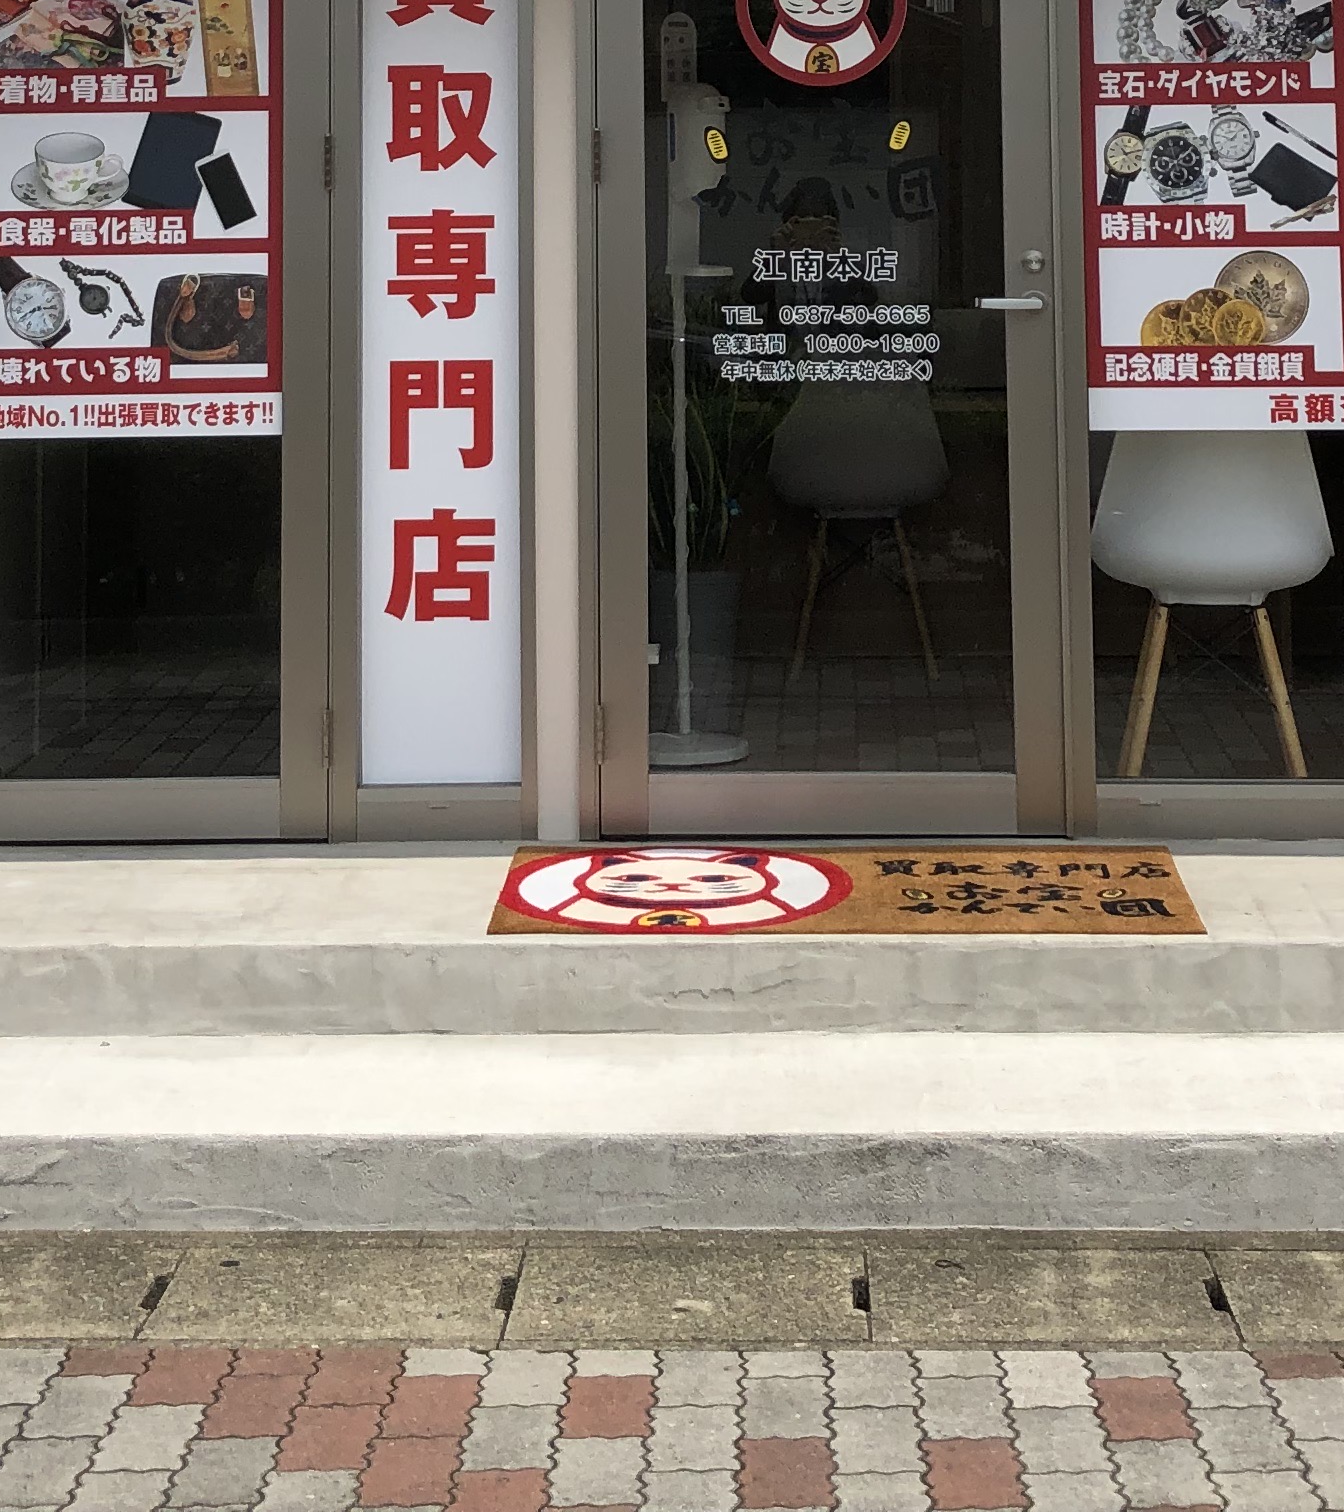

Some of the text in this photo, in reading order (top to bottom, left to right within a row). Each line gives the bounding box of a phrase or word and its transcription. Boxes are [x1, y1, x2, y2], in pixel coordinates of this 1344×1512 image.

[0, 74, 158, 104] 着物・骨董品
[1098, 69, 1301, 99] 宝石・ダイヤモンド
[1100, 211, 1235, 241] 時計・小物
[752, 248, 898, 282] 江南本店
[721, 305, 931, 325] TEL 0587-50-6665
[712, 334, 786, 355] 営業時間
[1105, 352, 1304, 382] 記念硬貨・金貨銀貨
